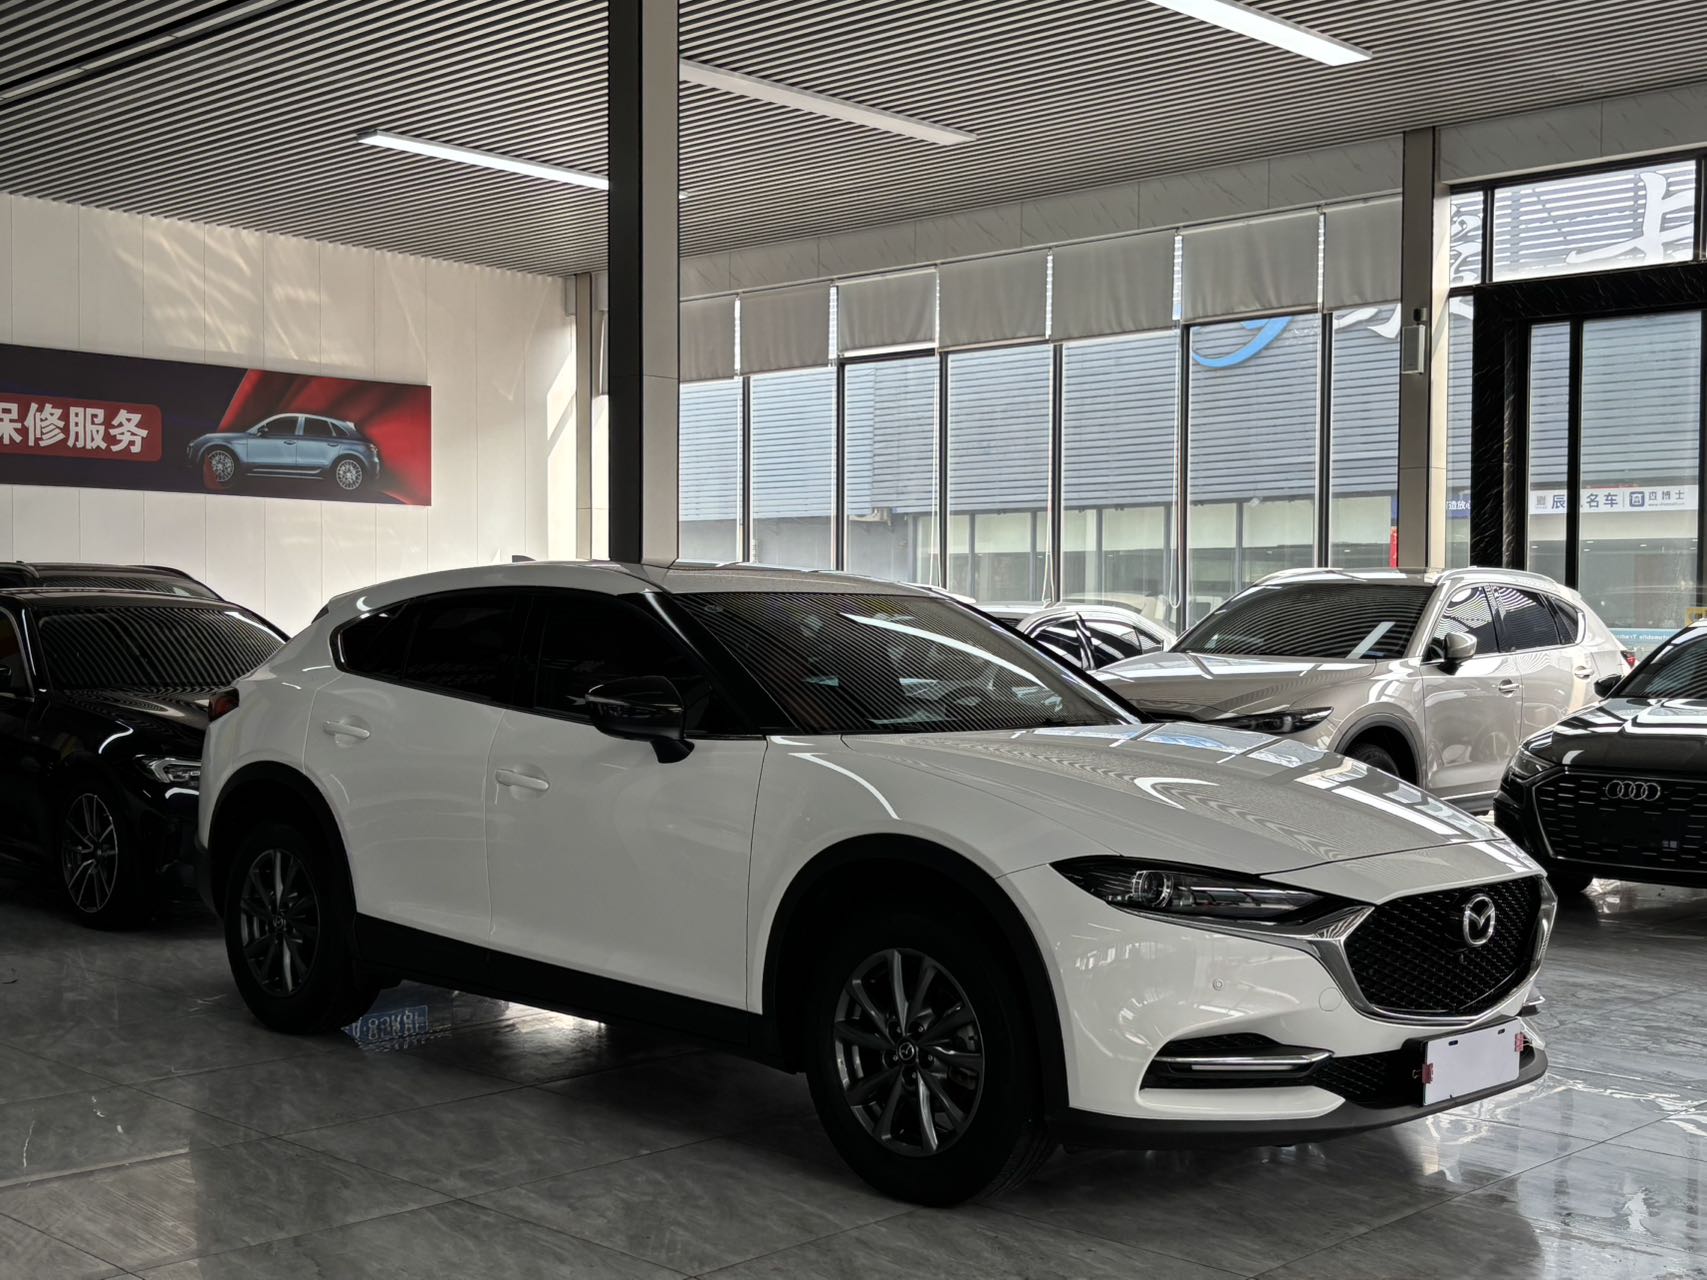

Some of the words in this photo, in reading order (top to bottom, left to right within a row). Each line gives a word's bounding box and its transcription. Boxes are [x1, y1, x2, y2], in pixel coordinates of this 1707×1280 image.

[0, 402, 148, 453] 保修服务
[1551, 492, 1618, 509] 辰名车
